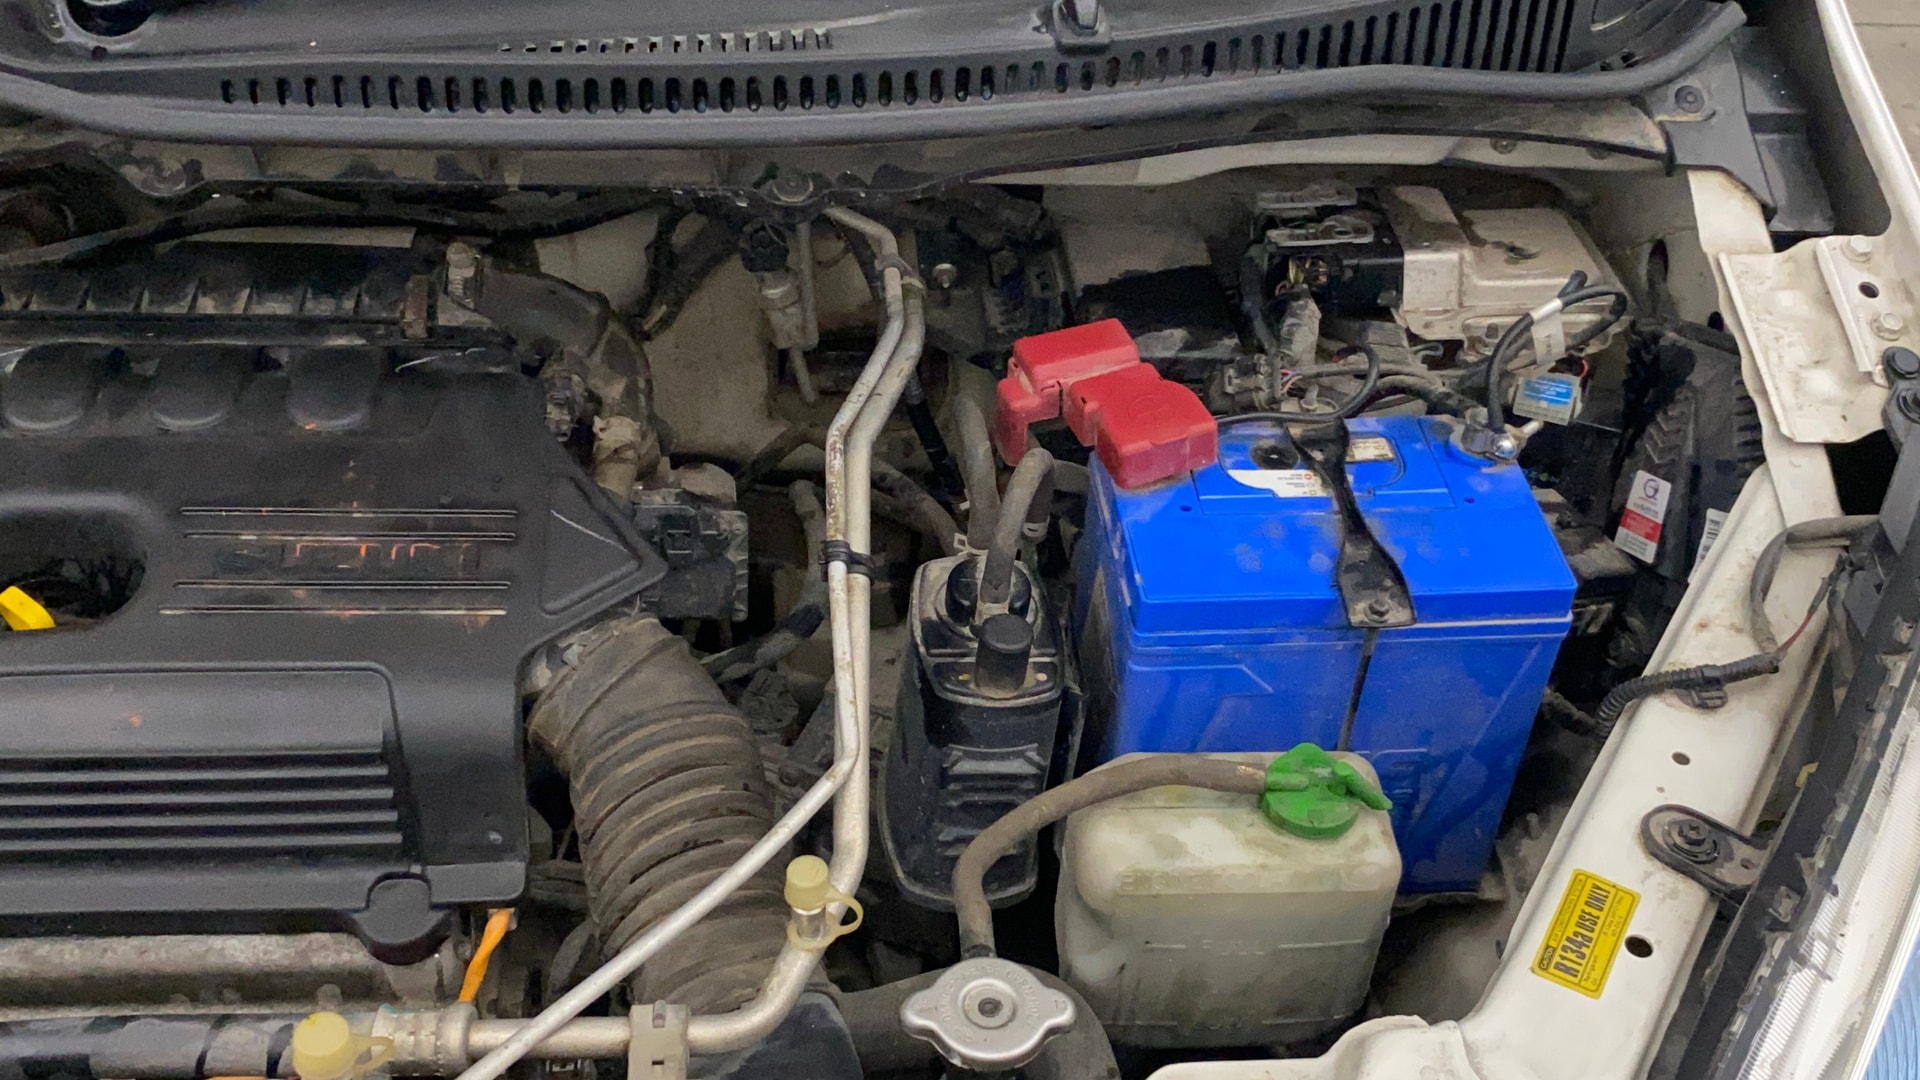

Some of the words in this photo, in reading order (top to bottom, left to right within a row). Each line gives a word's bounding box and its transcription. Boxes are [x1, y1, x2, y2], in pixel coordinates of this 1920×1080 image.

[1584, 883, 1611, 912] ONLY
[1576, 909, 1600, 933] USE
[1553, 931, 1594, 978] R134a
